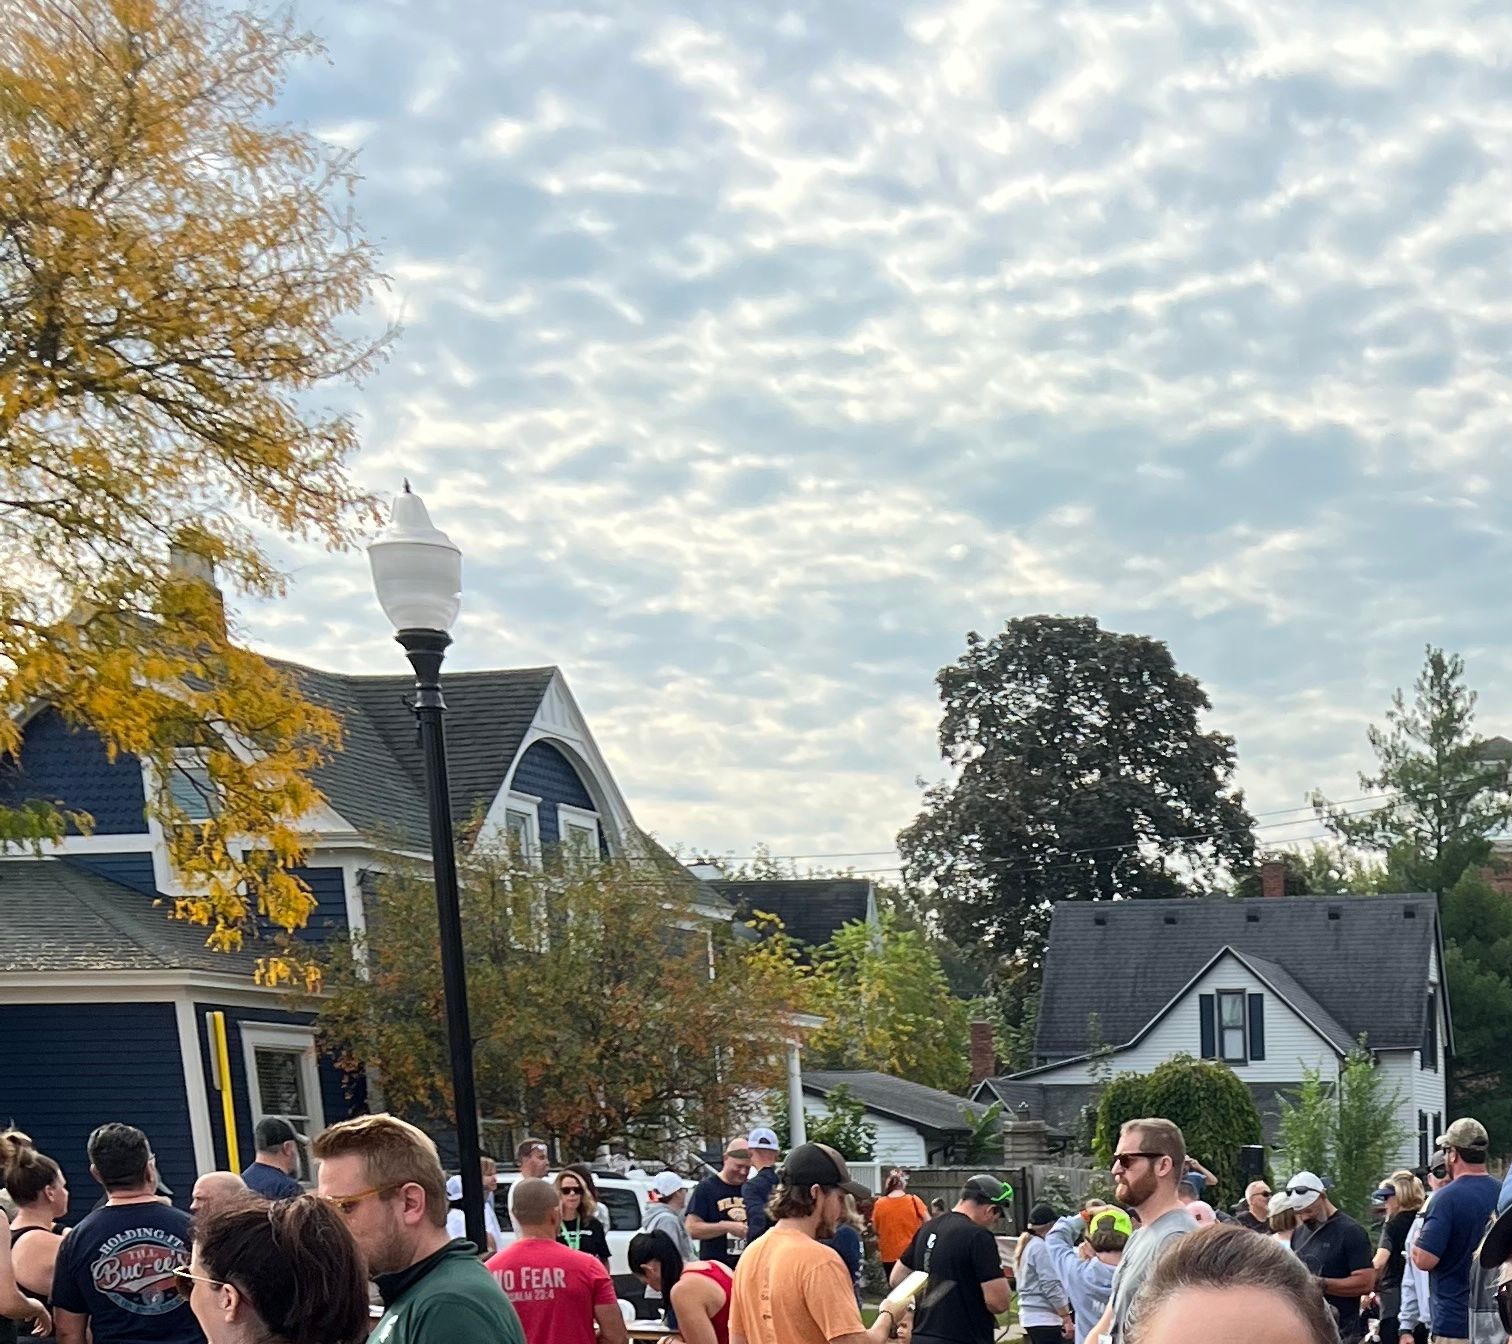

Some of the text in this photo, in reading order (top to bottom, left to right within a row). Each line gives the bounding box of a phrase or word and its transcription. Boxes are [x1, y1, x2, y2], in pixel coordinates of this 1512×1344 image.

[99, 1228, 184, 1254] HOLDING IT
[521, 1267, 566, 1289] FEAR
[508, 1291, 533, 1301] SALM
